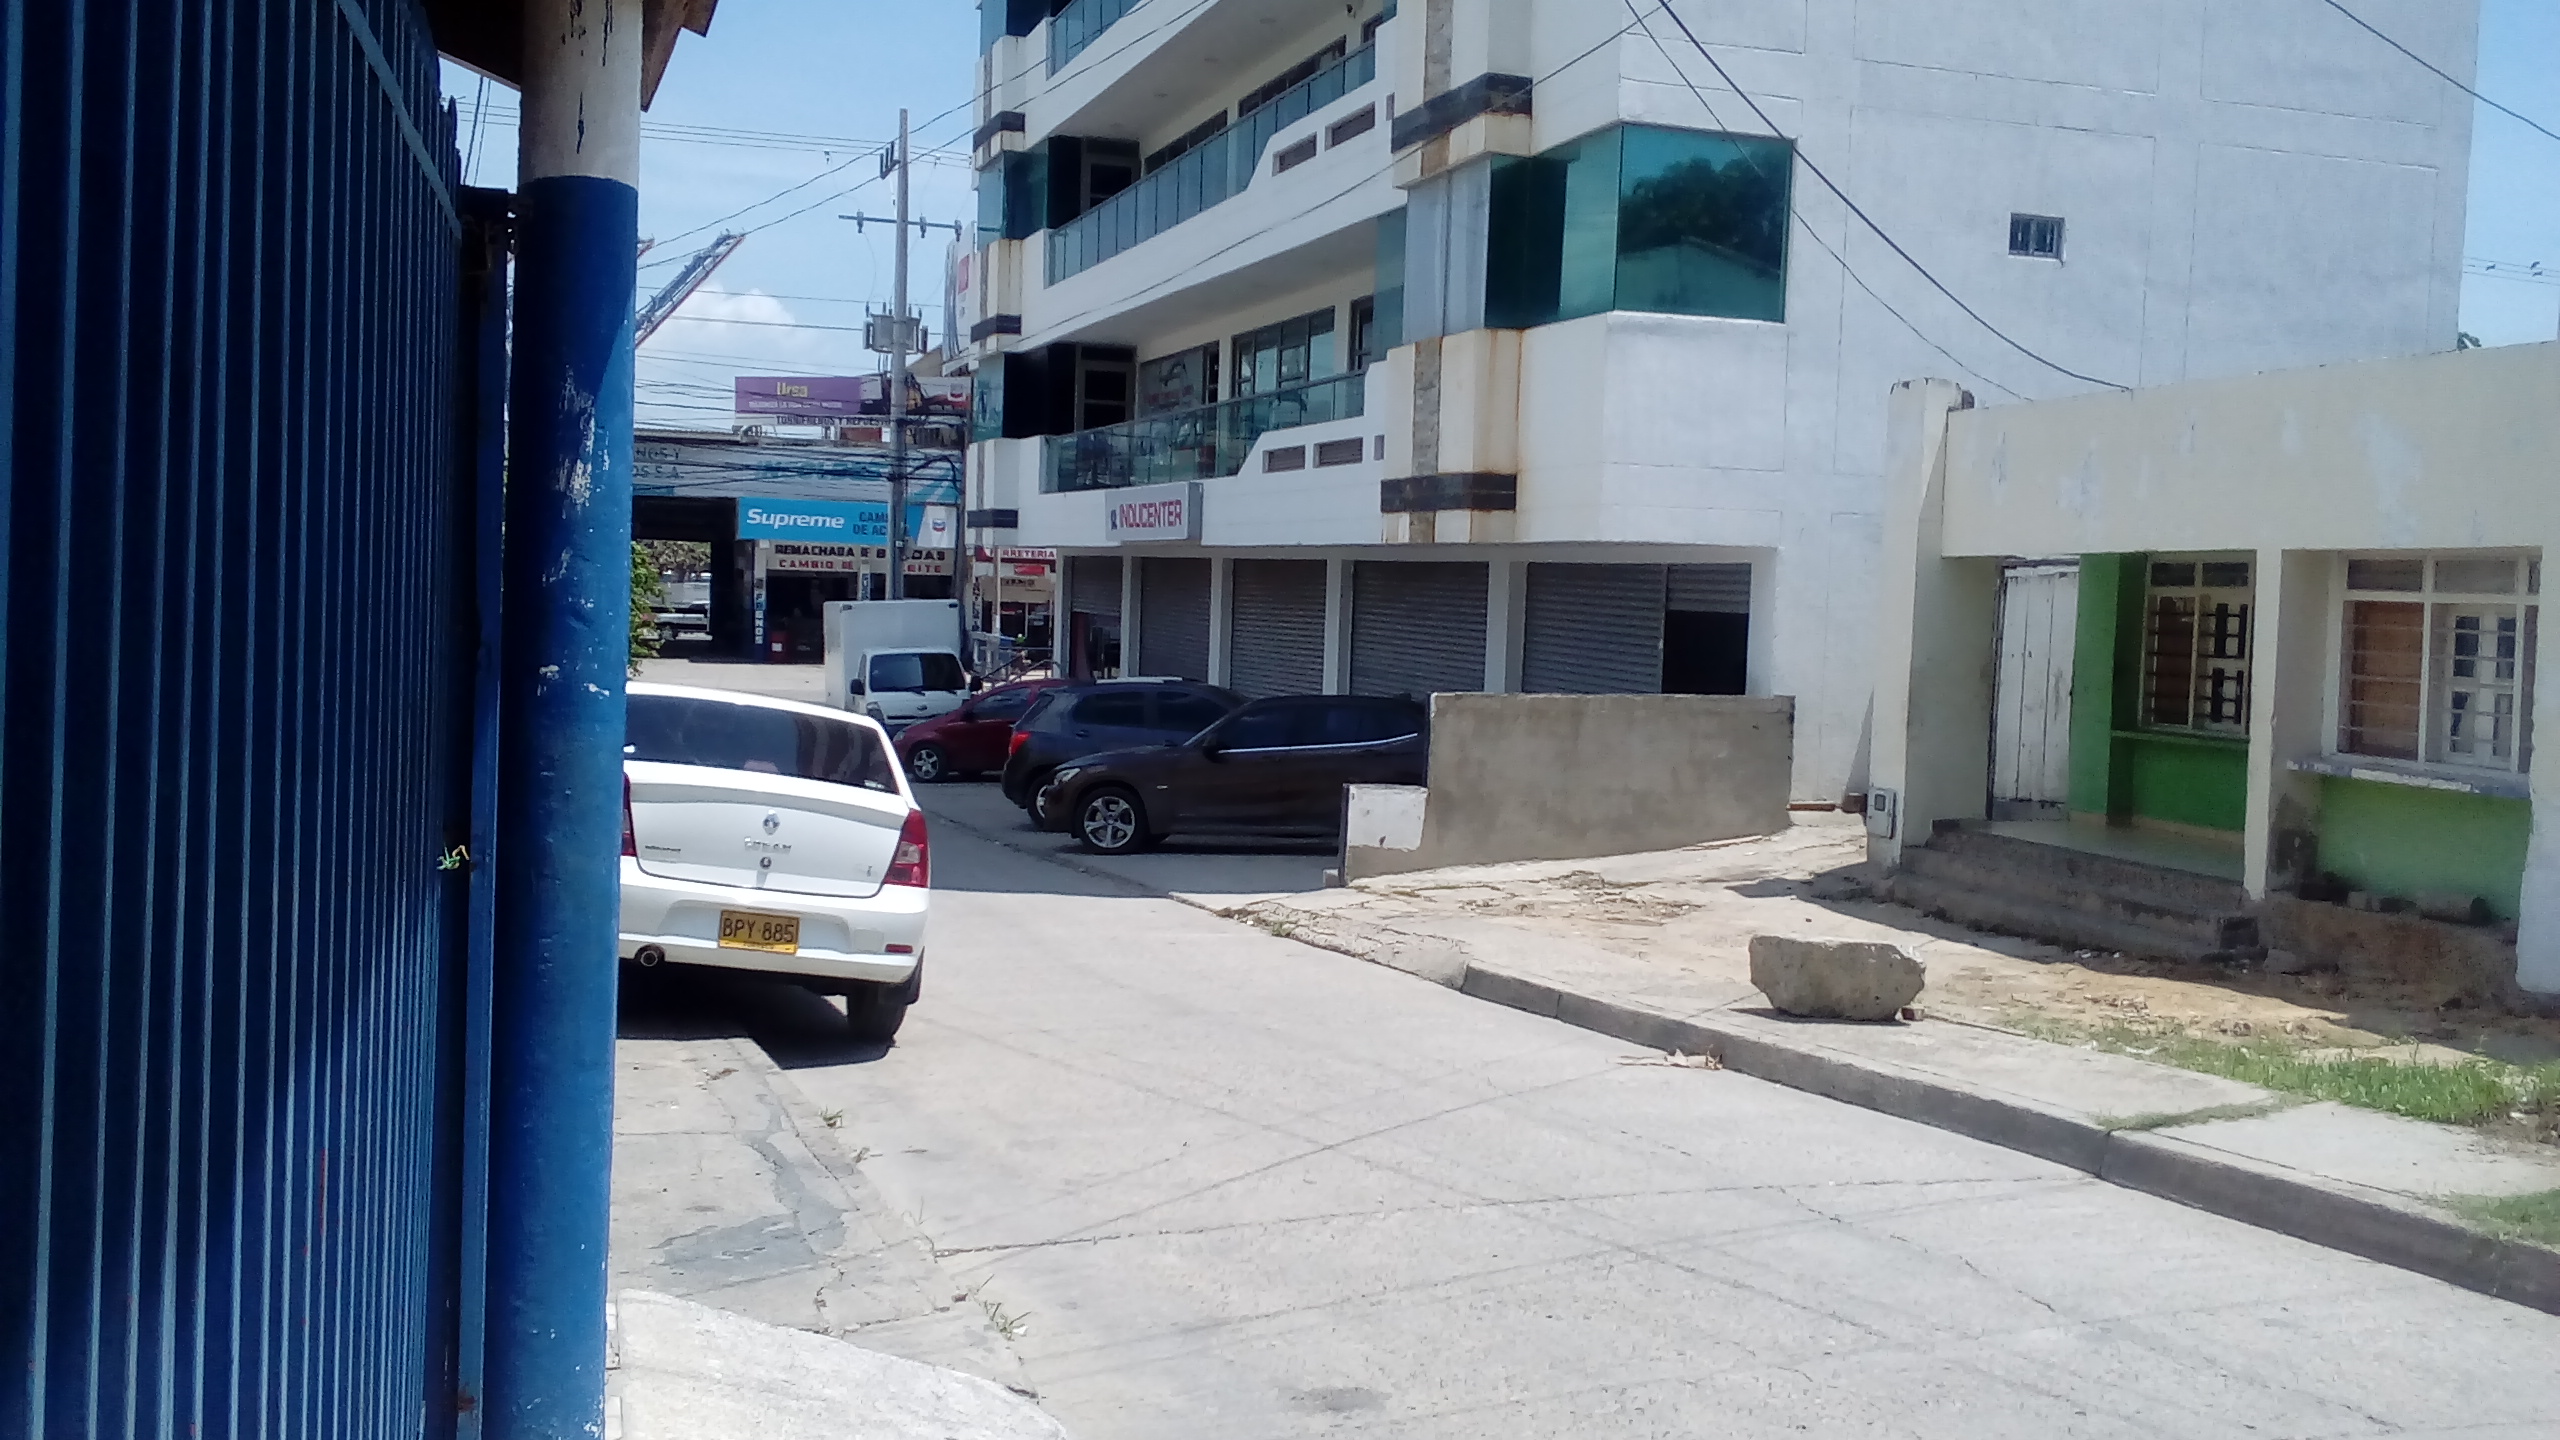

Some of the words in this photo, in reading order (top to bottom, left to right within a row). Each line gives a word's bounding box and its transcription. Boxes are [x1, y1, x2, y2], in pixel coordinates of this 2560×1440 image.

[746, 508, 845, 529] Supreme
[779, 559, 834, 570] CAMBIO
[722, 918, 756, 939] BPY
[762, 921, 795, 943] 885
